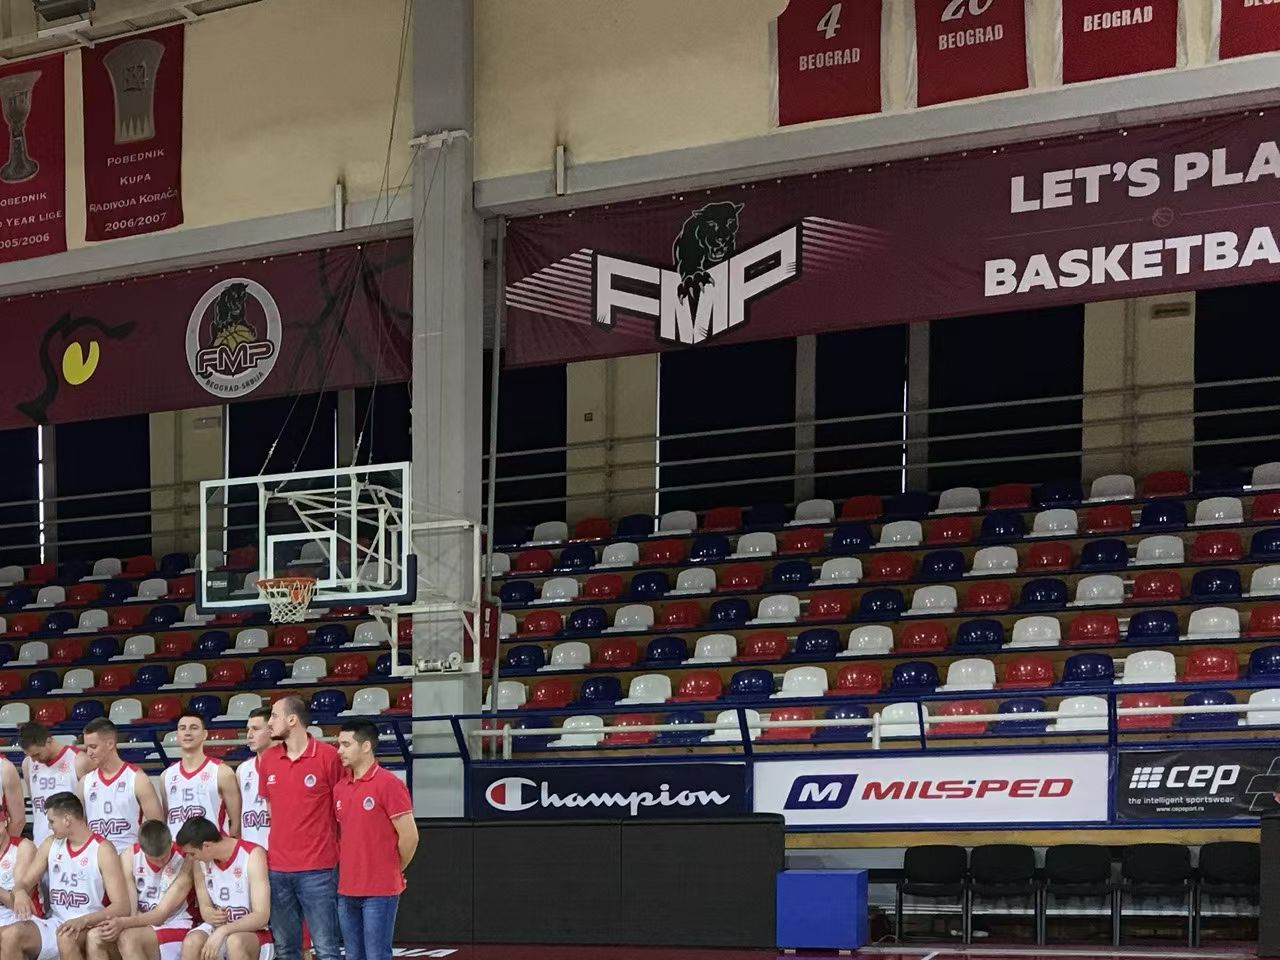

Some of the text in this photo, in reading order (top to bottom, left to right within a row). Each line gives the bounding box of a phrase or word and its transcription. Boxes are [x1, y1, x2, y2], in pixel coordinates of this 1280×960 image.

[816, 2, 842, 40] 4
[1083, 5, 1153, 33] BEOGRAD
[938, 24, 1004, 51] BEOGRAD
[799, 48, 861, 71] BEOGRAD
[107, 149, 165, 167] POBEDNIK
[120, 173, 152, 186] KUPA
[1010, 157, 1161, 214] LET'S
[6, 215, 35, 227] YEAR
[39, 209, 63, 221] LIGE
[104, 212, 167, 232] 2006/2007
[592, 222, 802, 346] FMP
[196, 340, 274, 375] FMP
[40, 777, 56, 790] 99
[798, 778, 1074, 802] M MILSPED
[1165, 764, 1241, 795] cep
[182, 788, 194, 801] 15
[485, 776, 731, 816] Champion
[1128, 796, 1235, 805] the intelligent sportswear
[89, 818, 131, 838] FMP
[60, 872, 78, 887] 45
[51, 889, 89, 910] FMP
[220, 887, 230, 901] 8
